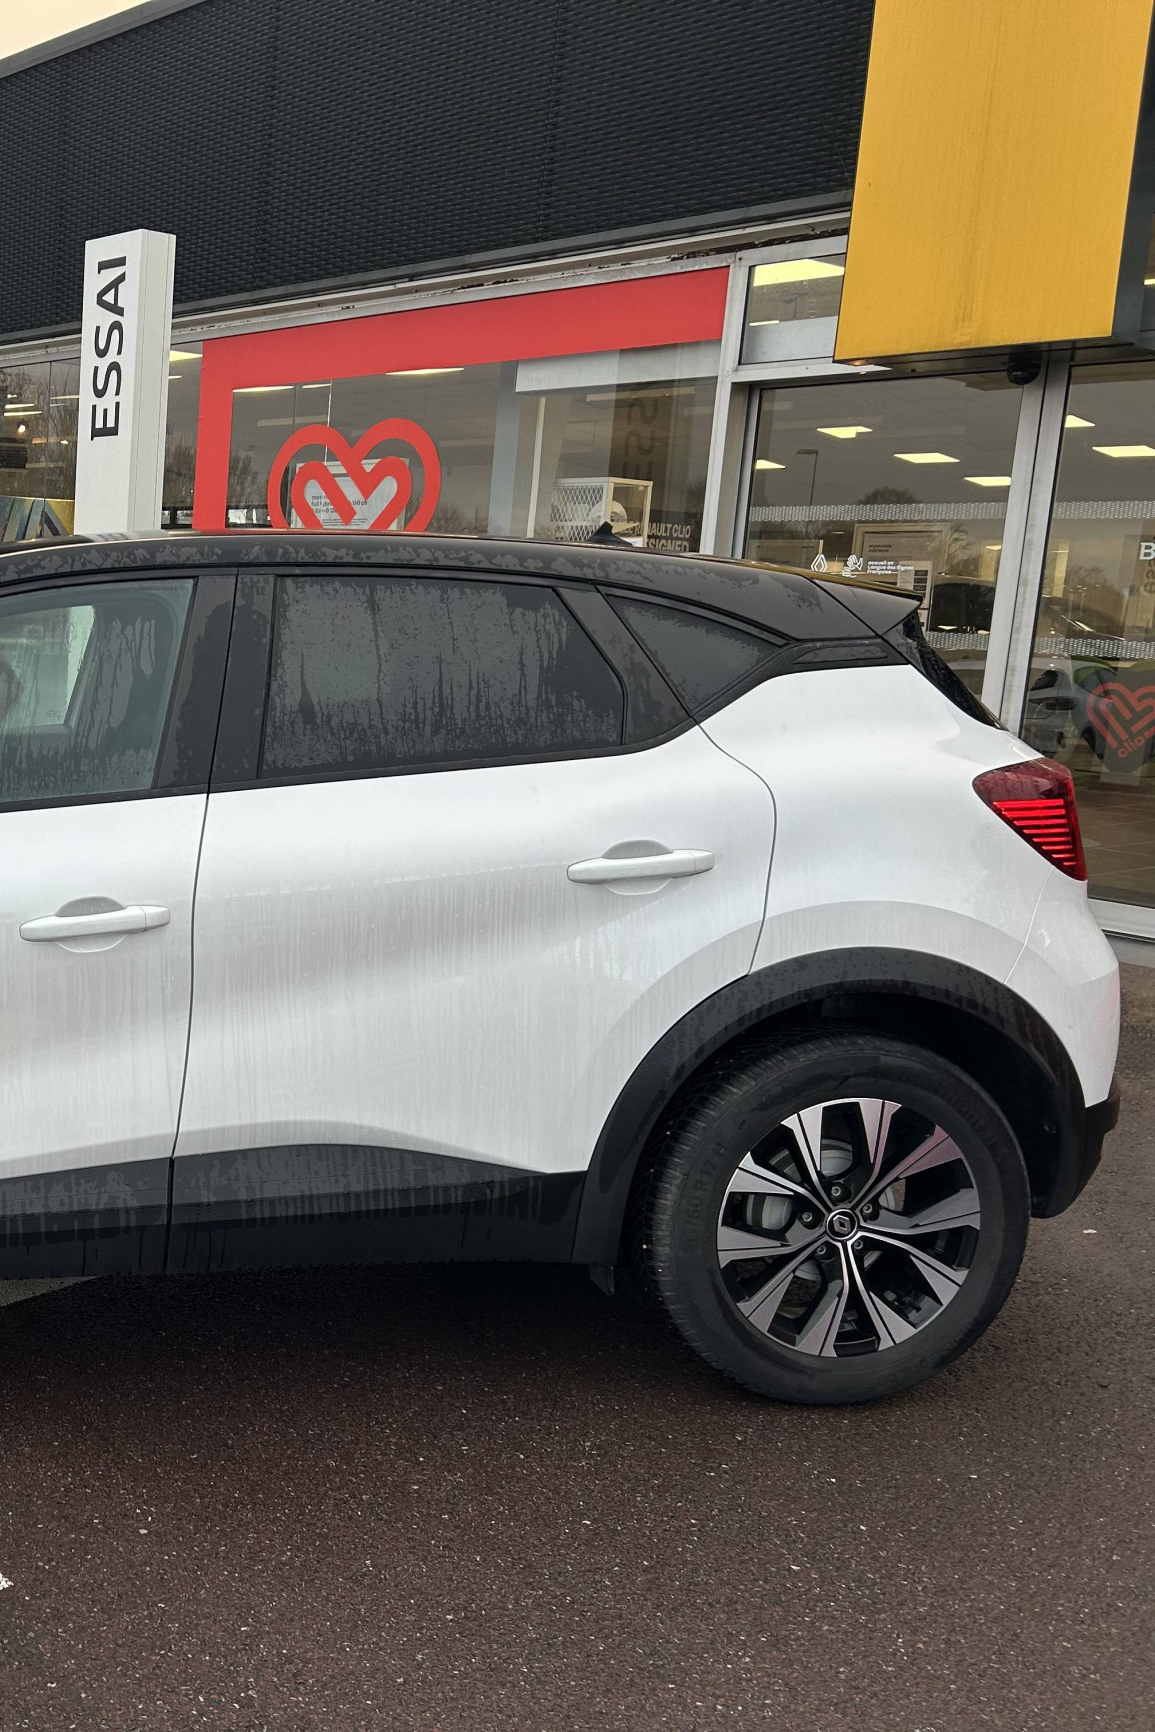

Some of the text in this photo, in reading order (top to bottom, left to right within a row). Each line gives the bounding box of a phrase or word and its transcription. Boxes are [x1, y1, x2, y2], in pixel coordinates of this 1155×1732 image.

[91, 256, 126, 441] ESSAI
[672, 524, 691, 538] CLIO
[1118, 736, 1144, 758] clio
